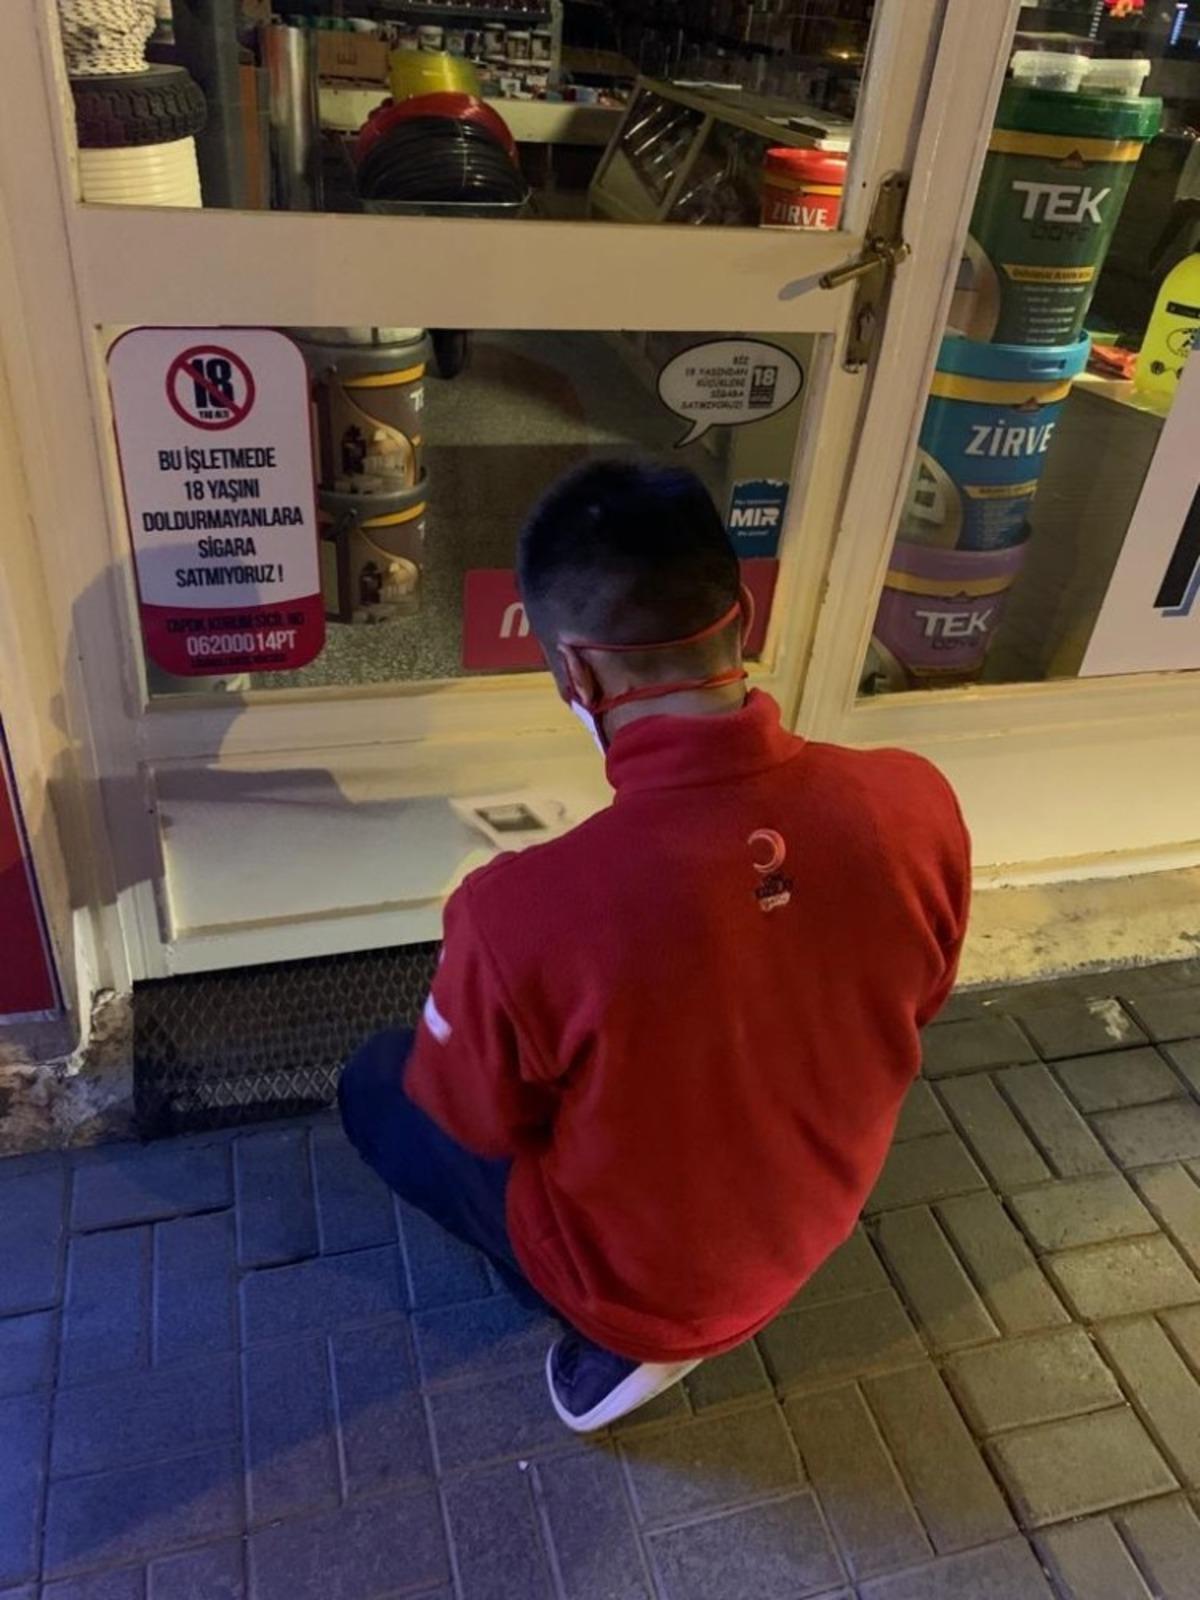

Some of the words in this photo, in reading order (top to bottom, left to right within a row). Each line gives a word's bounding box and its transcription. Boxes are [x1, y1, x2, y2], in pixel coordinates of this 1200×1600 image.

[1012, 180, 1112, 224] TEK
[191, 358, 235, 409] 18
[754, 368, 776, 387] 18
[965, 419, 1055, 457] ZİRVE
[158, 450, 182, 471] BU
[185, 446, 277, 474] İŞLETMEDE
[184, 480, 204, 501] 18
[207, 478, 260, 503] YAŞINI
[142, 507, 304, 532] DOLDURMAYANLARA
[198, 535, 256, 559] SİGARA
[175, 564, 275, 588] SATMIYORUZ
[915, 608, 994, 637] TEK
